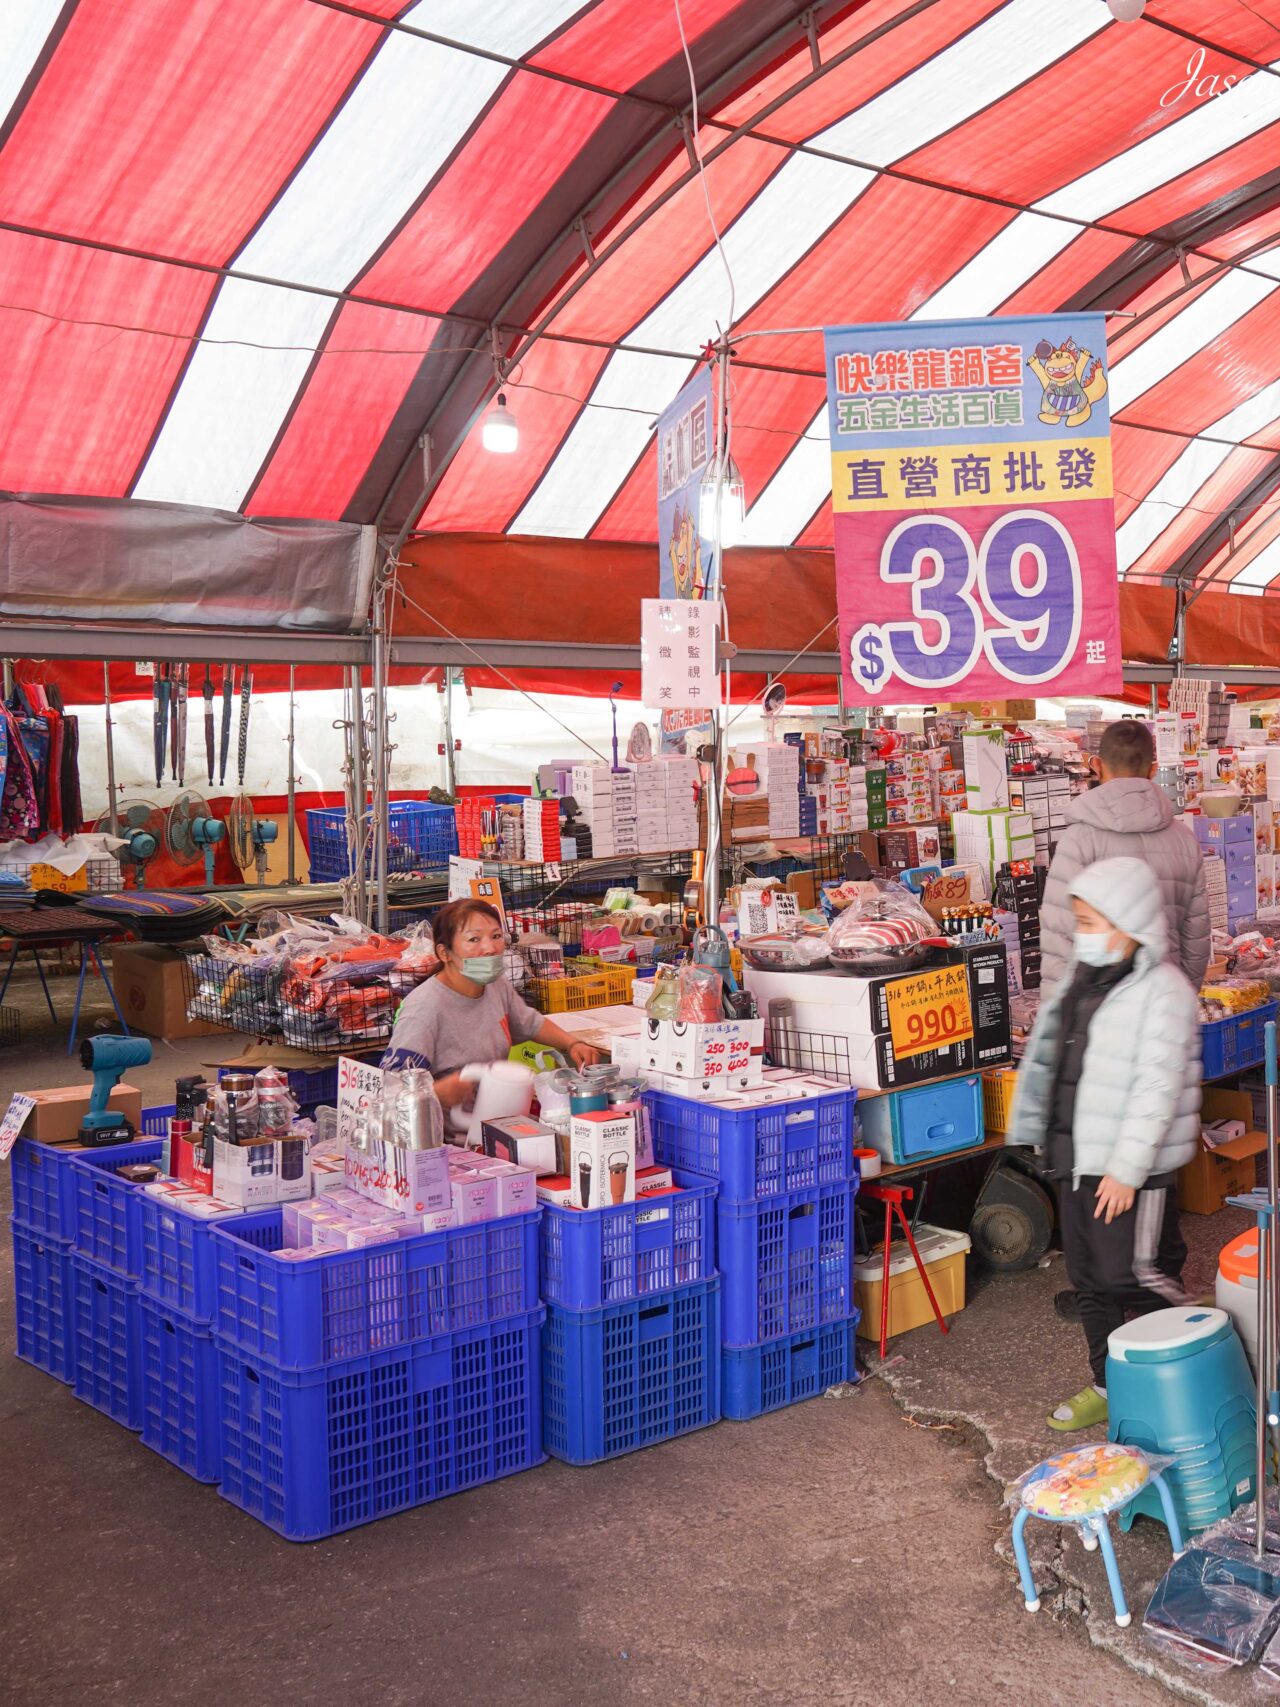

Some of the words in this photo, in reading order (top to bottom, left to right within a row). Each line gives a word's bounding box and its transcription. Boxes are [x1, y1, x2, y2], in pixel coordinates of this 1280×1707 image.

[835, 345, 1024, 396] 快樂龍鍋爸
[836, 389, 1024, 435] 五金生活百貨
[846, 446, 1098, 501] 直營商批發
[850, 509, 1083, 694] $39
[1085, 638, 1107, 665] 起
[687, 606, 700, 699] 錄影監視中
[906, 1004, 958, 1045] 990
[705, 1043, 726, 1055] 250
[729, 1041, 750, 1053] 300
[703, 1062, 723, 1077] 350
[727, 1058, 749, 1072] 400
[574, 1125, 592, 1134] CLASSIC
[602, 1125, 630, 1134] CLASSIC
[602, 1131, 627, 1139] BOTTLE
[641, 1181, 667, 1193] CLASSIC
